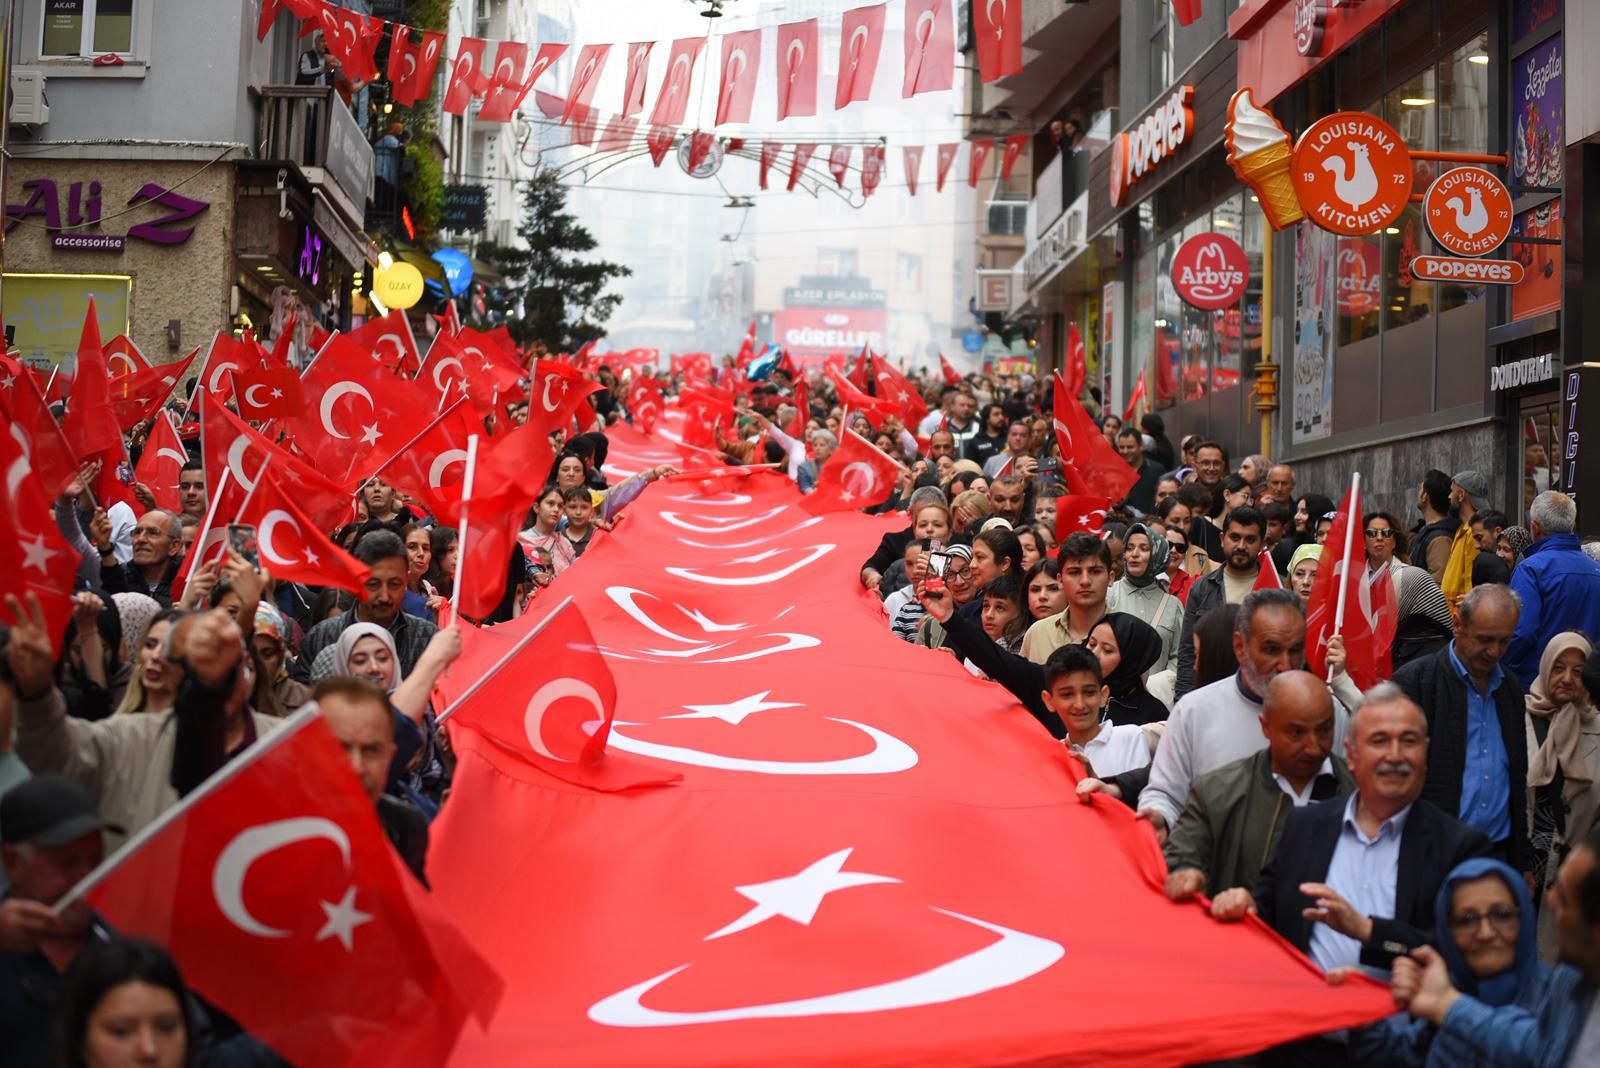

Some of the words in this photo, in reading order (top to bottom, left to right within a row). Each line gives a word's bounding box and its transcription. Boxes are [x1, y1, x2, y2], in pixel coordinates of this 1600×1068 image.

[1311, 122, 1396, 156] LOUISIANA
[1303, 172, 1316, 183] 19
[1392, 174, 1406, 185] 72
[1437, 171, 1501, 197] LOUISIANA
[5, 178, 103, 234] Ali
[127, 182, 211, 245] Z
[1317, 201, 1393, 228] KITCHEN
[1431, 208, 1441, 217] 19
[1498, 210, 1509, 219] 72
[55, 236, 122, 248] accessorise
[1442, 231, 1498, 252] KITCHEN
[1179, 265, 1244, 289] Arby's
[986, 280, 1007, 303] E
[1490, 353, 1553, 391] DONDURMA
